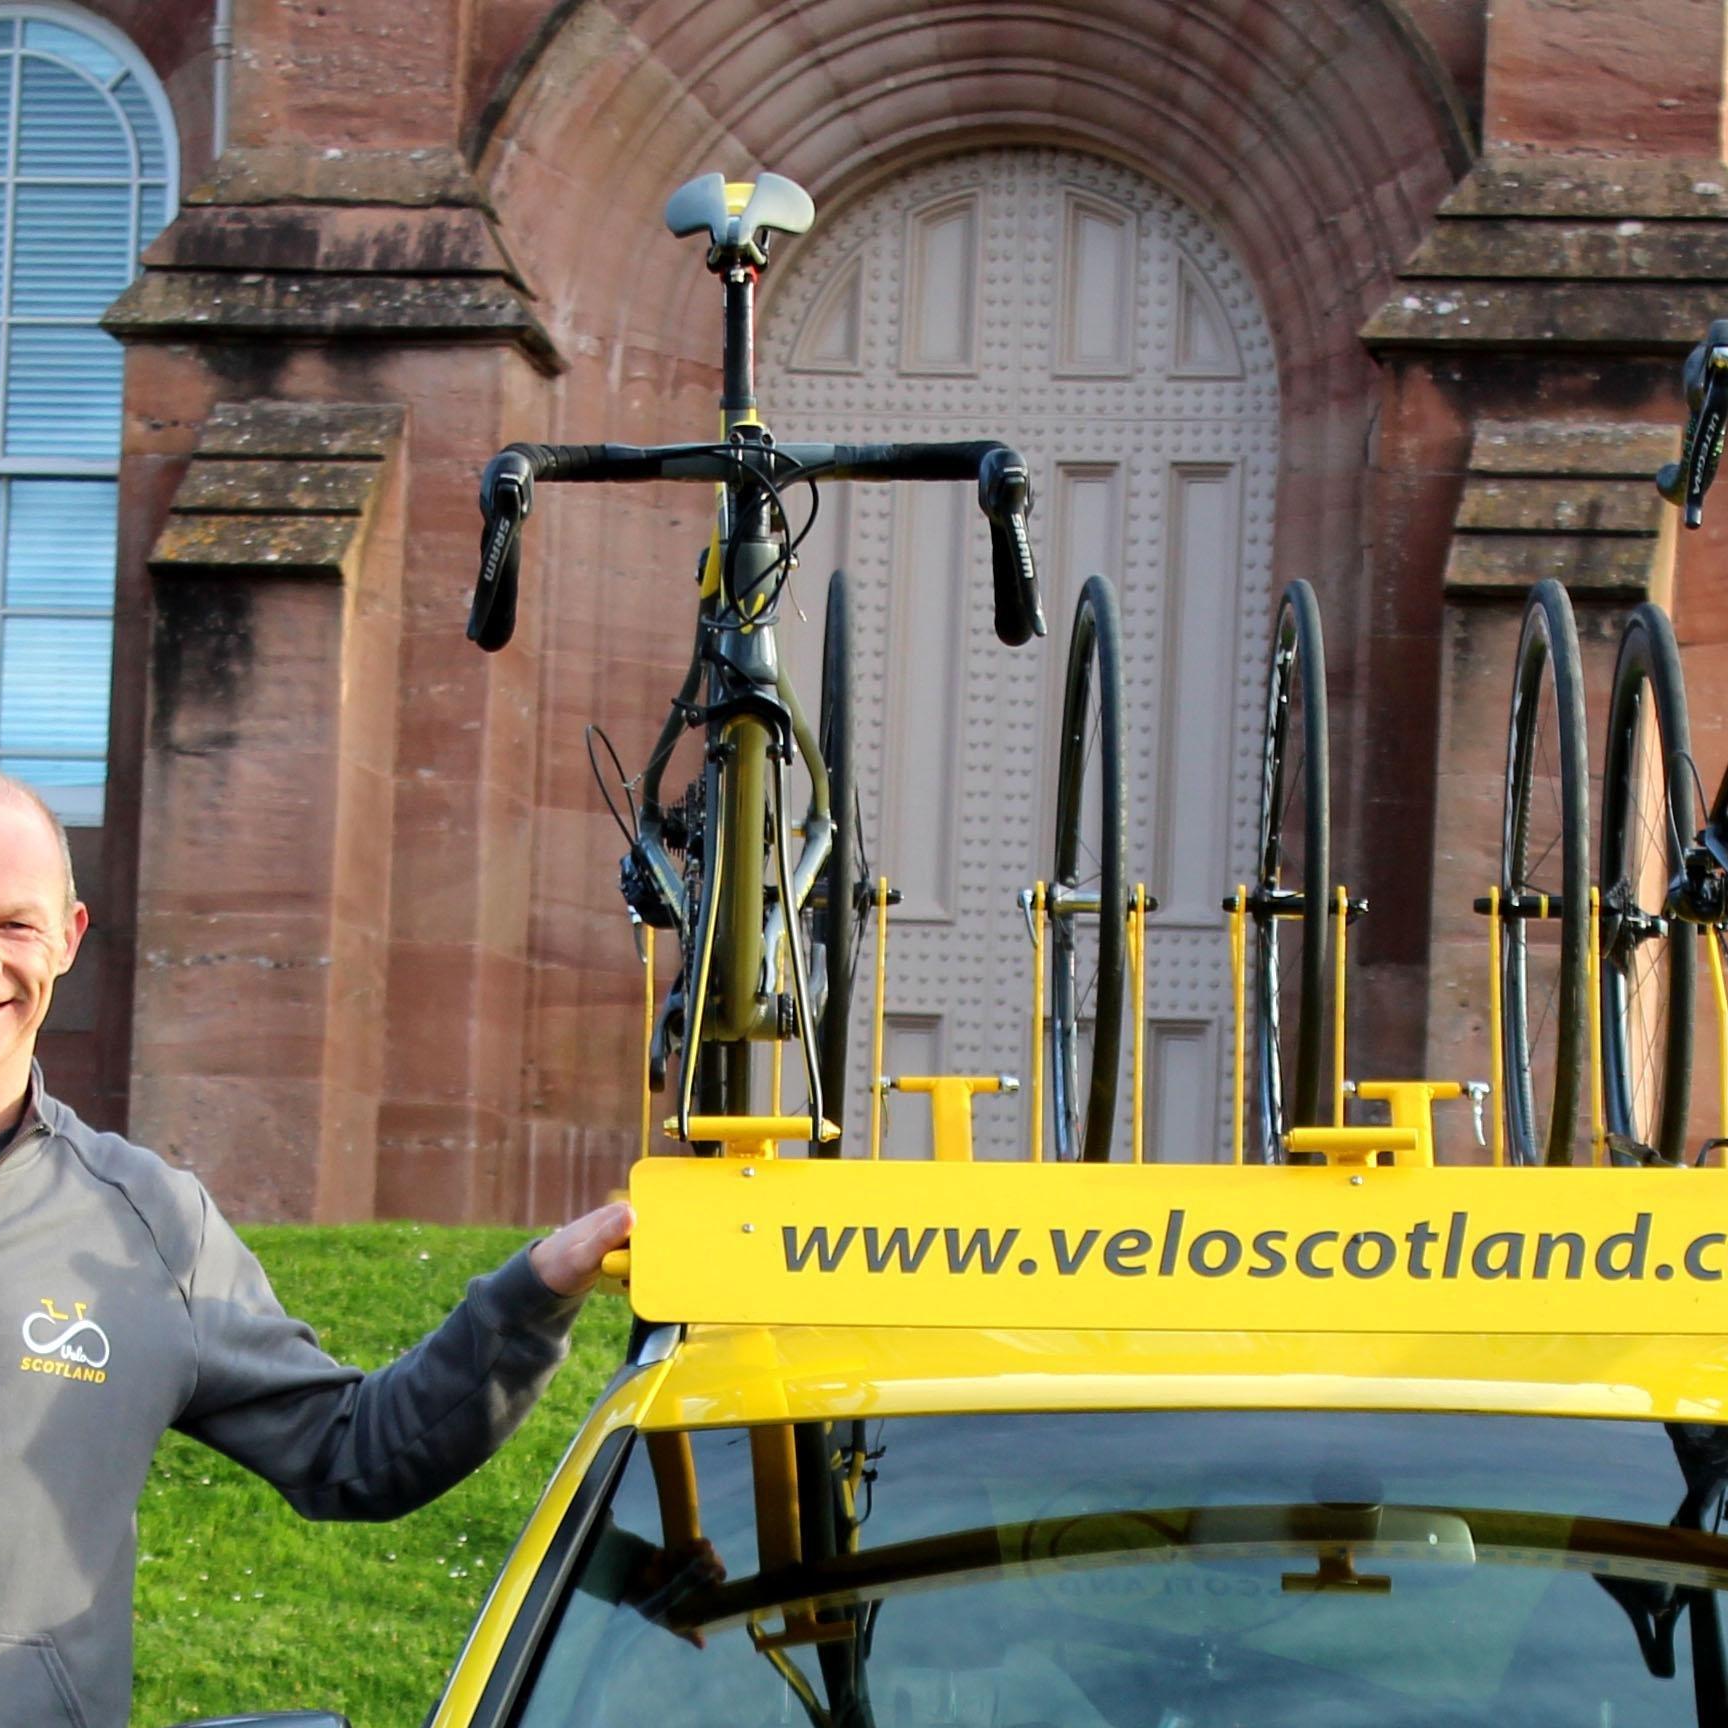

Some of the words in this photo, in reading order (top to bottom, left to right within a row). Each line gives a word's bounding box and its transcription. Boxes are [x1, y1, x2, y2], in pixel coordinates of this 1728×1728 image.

[1692, 412, 1720, 495] ULTEGRA
[1011, 513, 1034, 579] SRAM
[20, 1357, 106, 1384] SCOTLAND
